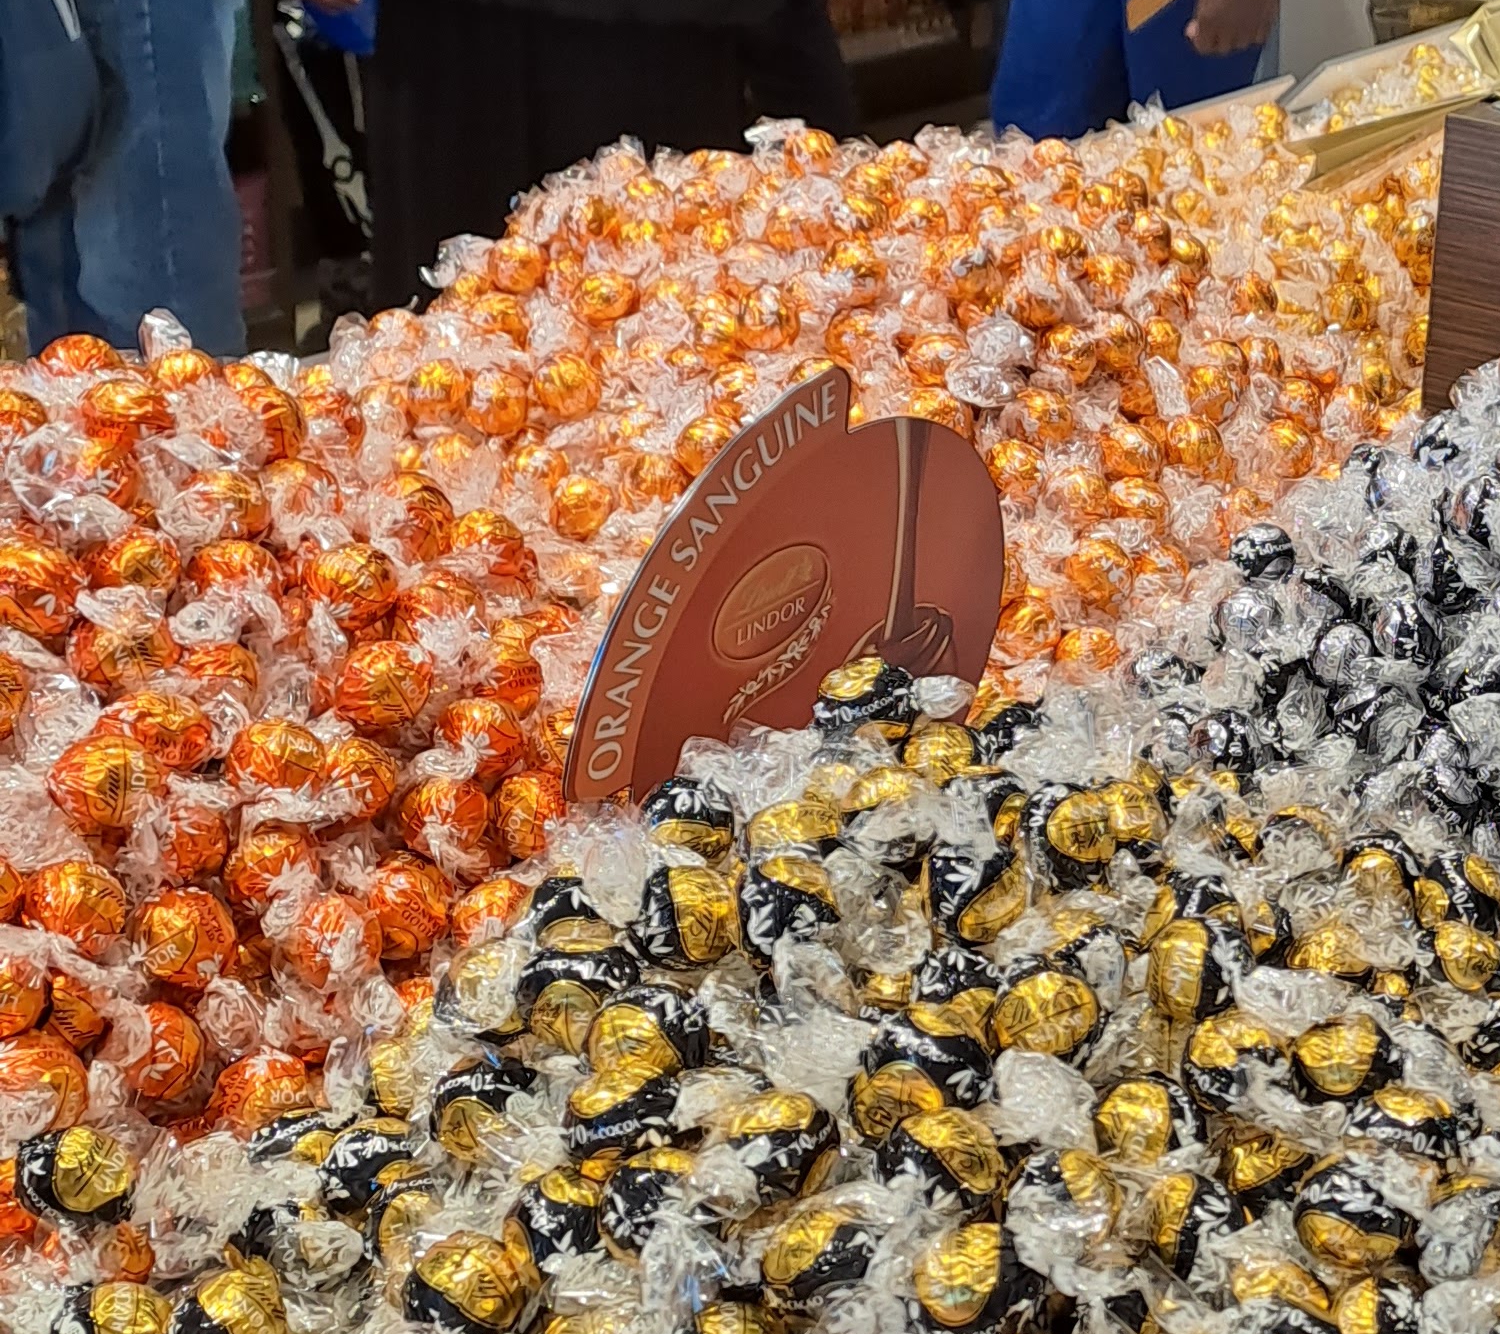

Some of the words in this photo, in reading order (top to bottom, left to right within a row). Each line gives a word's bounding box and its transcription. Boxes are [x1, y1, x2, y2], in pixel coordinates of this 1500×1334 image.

[586, 572, 682, 781] ORANGE
[670, 377, 838, 572] SANGUINE
[736, 596, 806, 646] LINDOR
